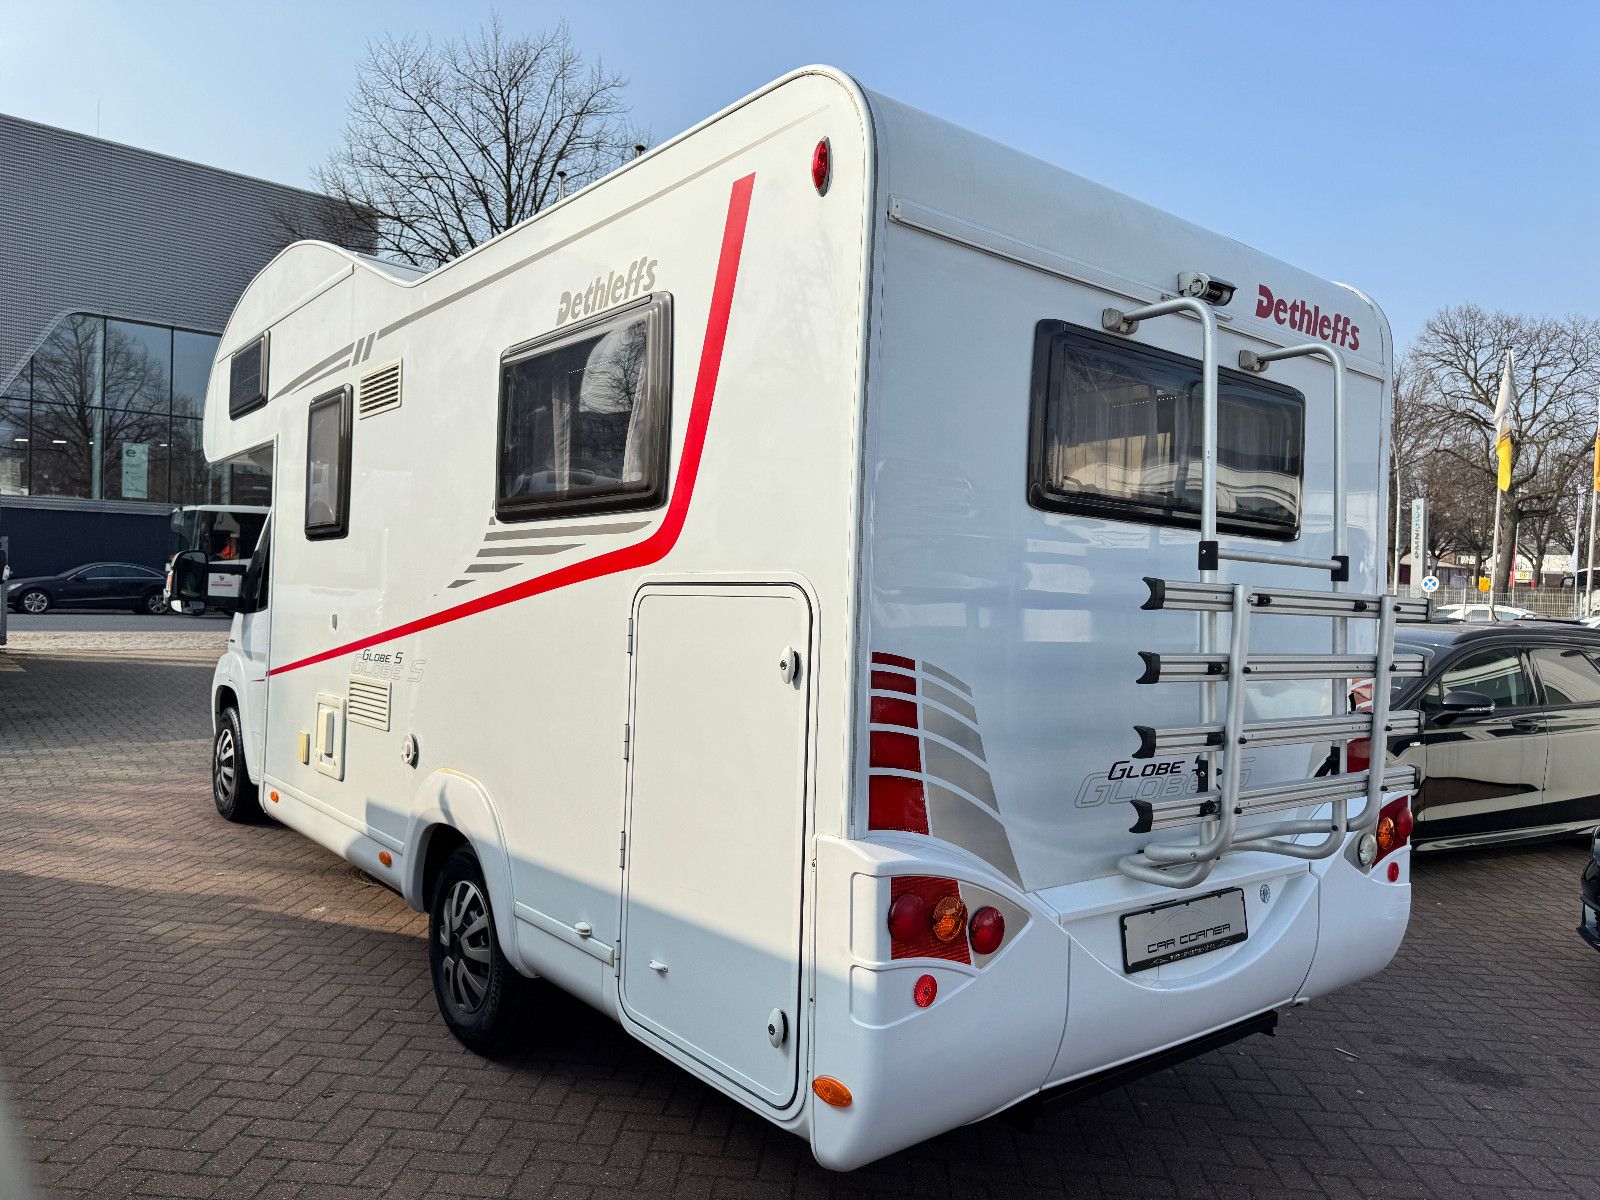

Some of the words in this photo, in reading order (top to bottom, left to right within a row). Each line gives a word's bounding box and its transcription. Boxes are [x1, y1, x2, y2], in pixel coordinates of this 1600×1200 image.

[556, 256, 657, 326] Dethleffs
[1255, 284, 1360, 351] Dethleffs
[1147, 938, 1176, 954] CAR
[1179, 923, 1231, 945] CORNER
